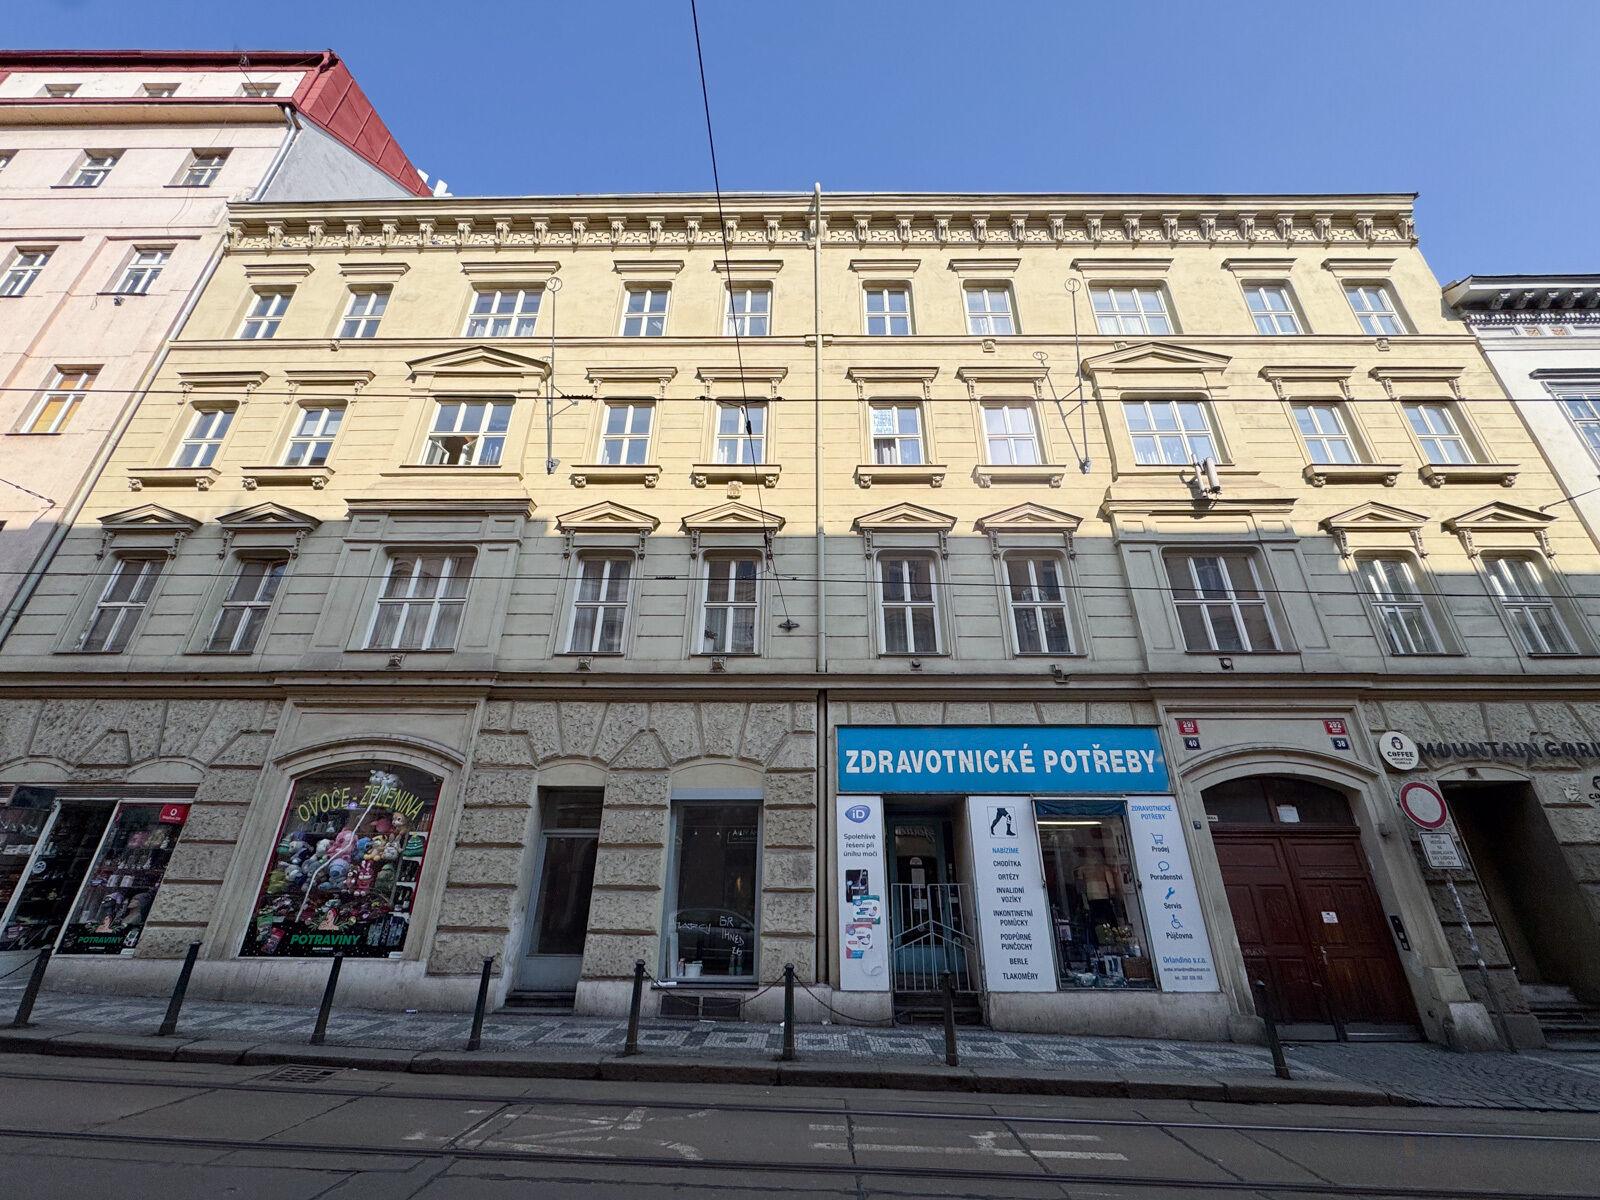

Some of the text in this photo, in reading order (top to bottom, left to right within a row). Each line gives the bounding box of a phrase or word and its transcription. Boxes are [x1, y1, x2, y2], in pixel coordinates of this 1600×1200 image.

[845, 743, 1156, 774] ZDRAVOTNICKÉ POTŘEBY
[298, 786, 351, 822] OVOČE
[359, 785, 425, 820] ZELENINA
[1131, 804, 1173, 812] ZDRAVOTNICKÉ
[1141, 812, 1166, 820] POTŘEBY
[992, 846, 1021, 854] NABÍZÍME
[993, 859, 1022, 867] CHODÍTKA
[997, 872, 1020, 880] ORTÉZY
[1150, 873, 1184, 881] Poradenství
[996, 886, 1025, 894] INVALIDNÍ
[1001, 895, 1022, 903] VOZÍKY
[1163, 902, 1182, 910] Servis
[1000, 918, 1029, 926] POMŮCKY
[77, 936, 124, 944] POTRAVINY
[289, 934, 362, 945] POTRAVINY
[1000, 931, 1033, 941] PODPŮRNÉ
[1166, 931, 1194, 941] Půjčovna
[1001, 942, 1033, 951] PUNČOCHY
[1009, 957, 1029, 965] BERLE
[1002, 971, 1039, 980] TLAKOMĚRY
